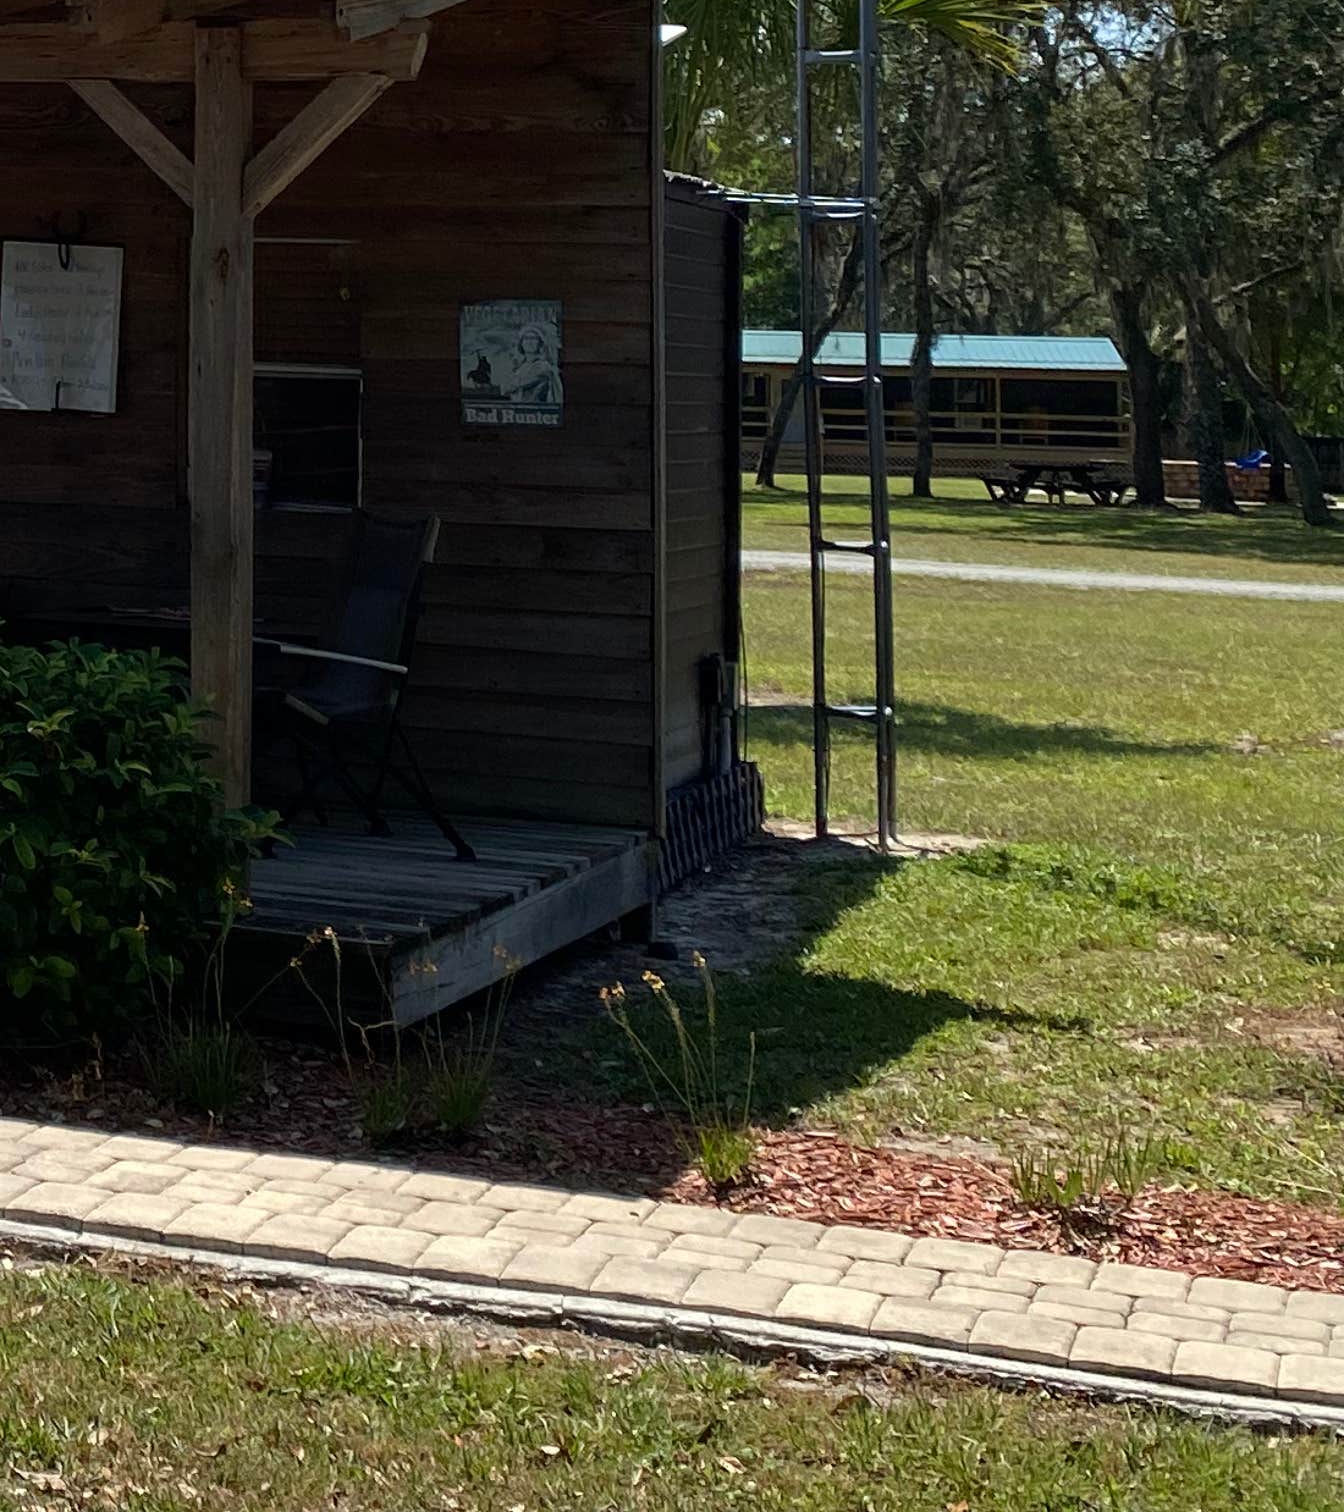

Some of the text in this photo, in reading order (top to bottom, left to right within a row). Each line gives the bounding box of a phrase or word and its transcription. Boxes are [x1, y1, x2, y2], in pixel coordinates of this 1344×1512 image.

[463, 305, 559, 324] VEGETARIAN
[465, 408, 560, 425] Bad Hunter
